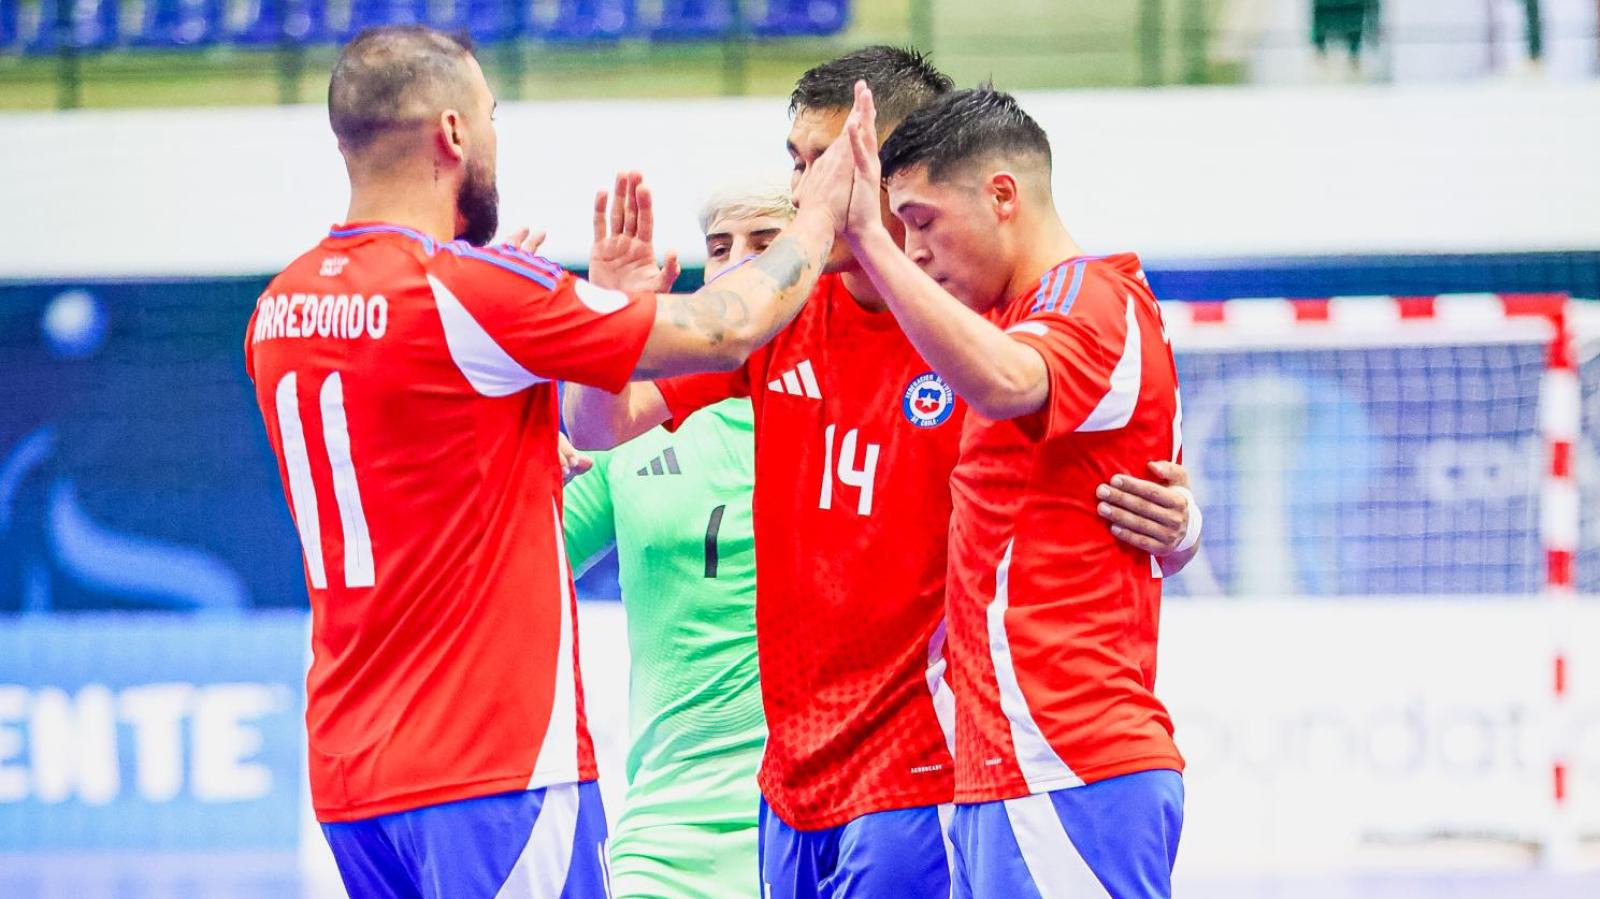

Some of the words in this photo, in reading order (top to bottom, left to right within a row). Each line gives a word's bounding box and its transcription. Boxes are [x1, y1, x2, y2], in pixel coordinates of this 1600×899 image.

[275, 371, 376, 589] 11
[819, 423, 880, 516] 14
[704, 504, 726, 578] 1
